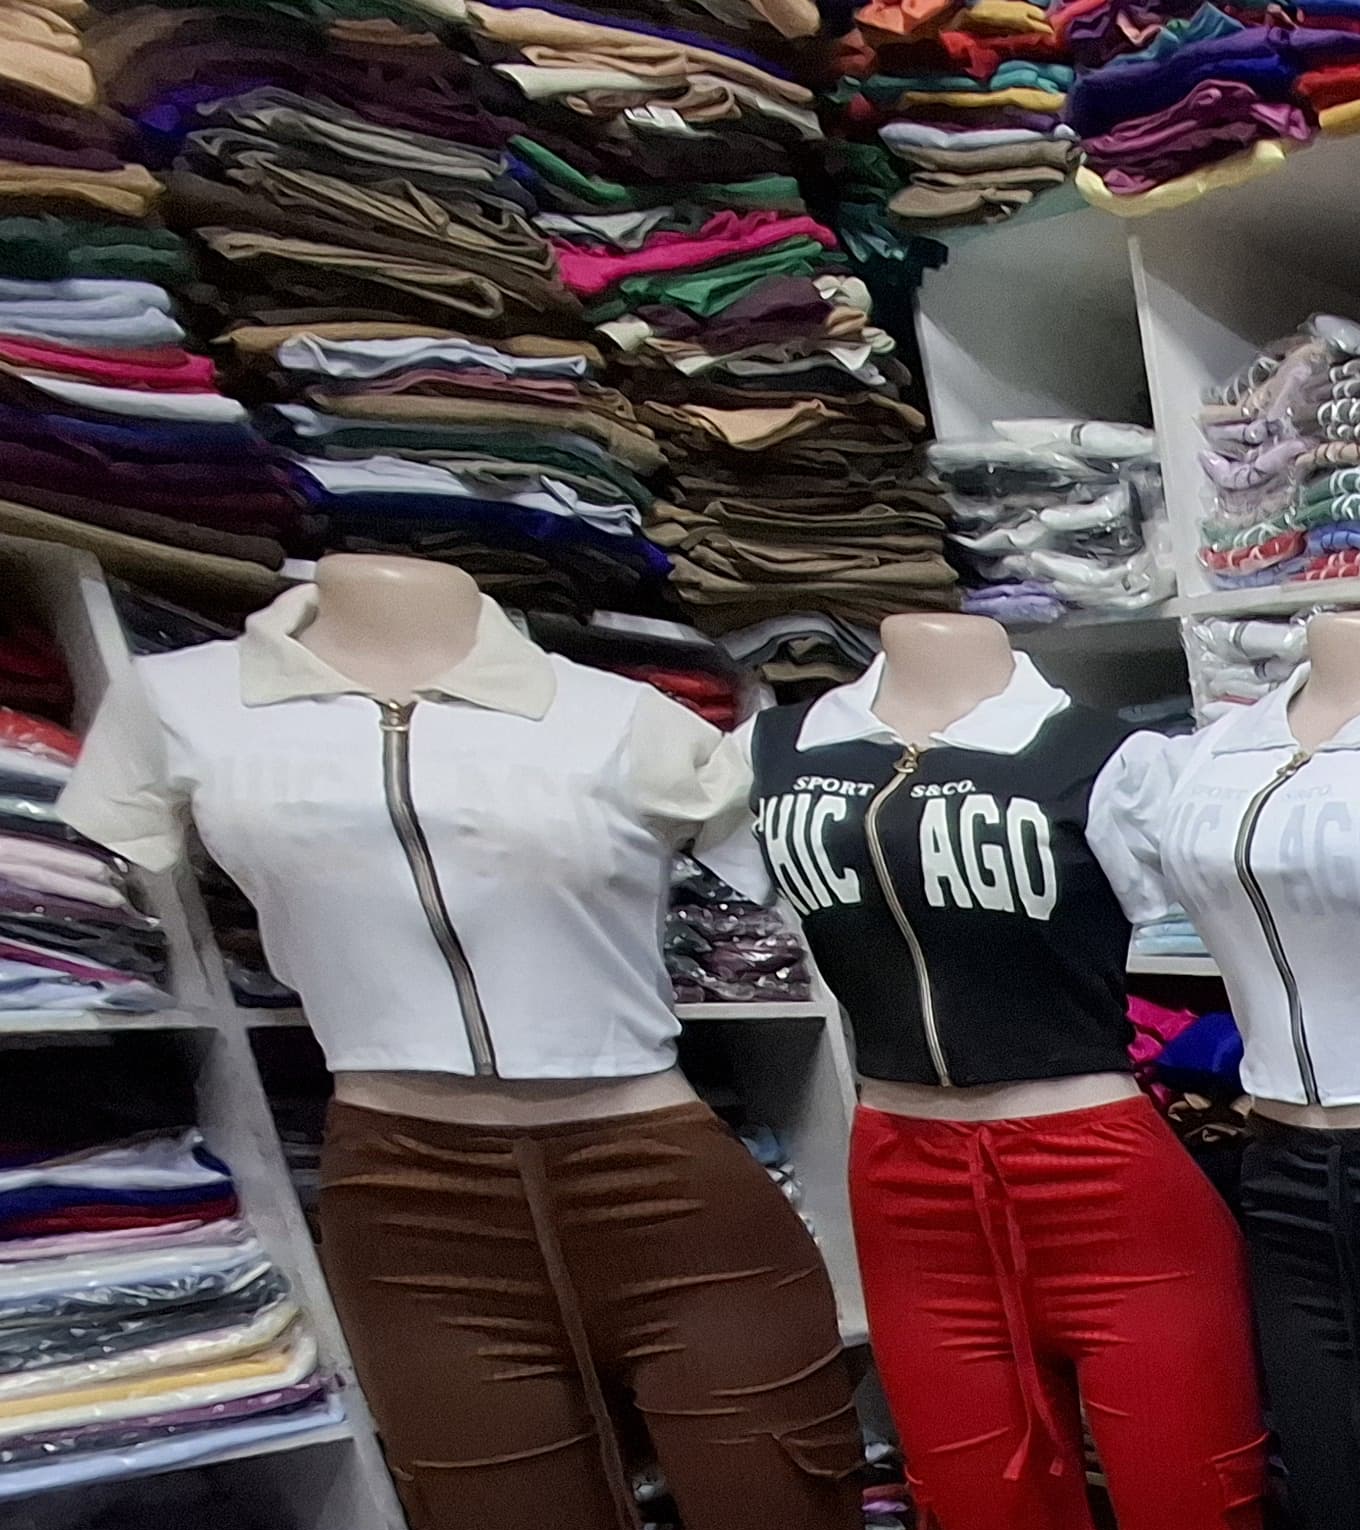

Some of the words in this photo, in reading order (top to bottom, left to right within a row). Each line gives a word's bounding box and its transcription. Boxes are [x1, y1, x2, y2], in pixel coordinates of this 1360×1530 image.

[793, 775, 875, 797] SPORT
[909, 778, 977, 799] S&CO.
[752, 792, 862, 917] HIC
[920, 793, 1057, 921] AGO
